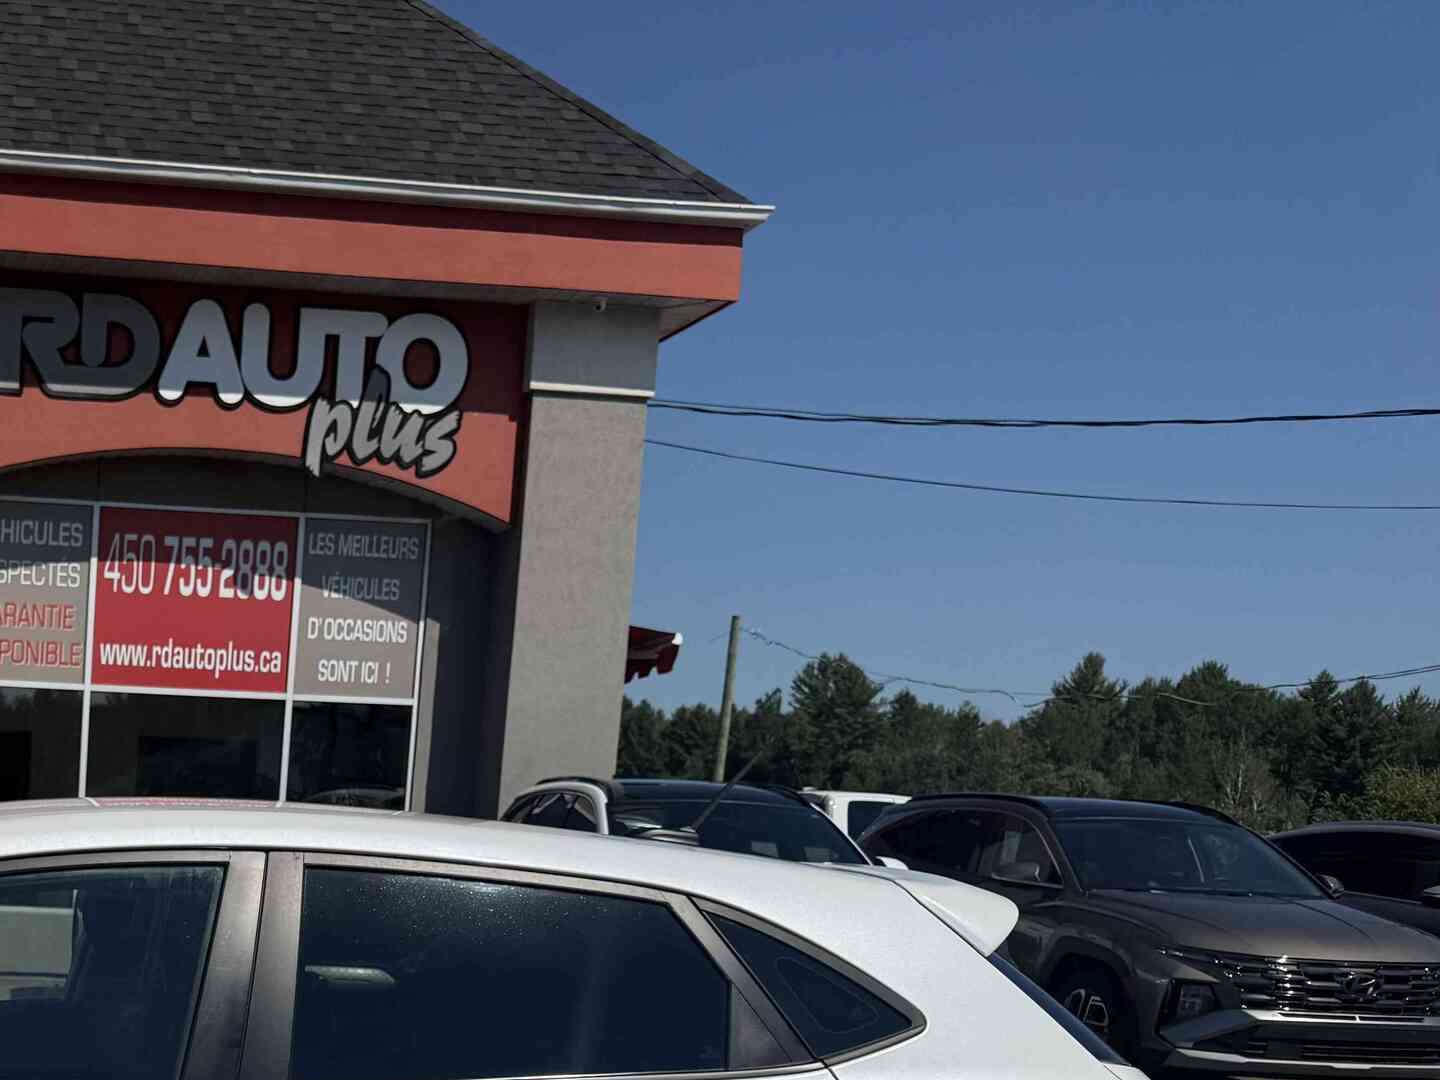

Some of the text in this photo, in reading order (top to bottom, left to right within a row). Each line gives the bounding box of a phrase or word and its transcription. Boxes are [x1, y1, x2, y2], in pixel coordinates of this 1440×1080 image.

[304, 364, 460, 477] plus
[308, 532, 420, 560] LES MEILLEURS
[103, 531, 157, 595] 450
[321, 571, 401, 601] VÉHICULES
[306, 616, 408, 644] D'OCCASIONS
[99, 637, 283, 680] www.rdautoplus.ca
[317, 659, 359, 684] SONT
